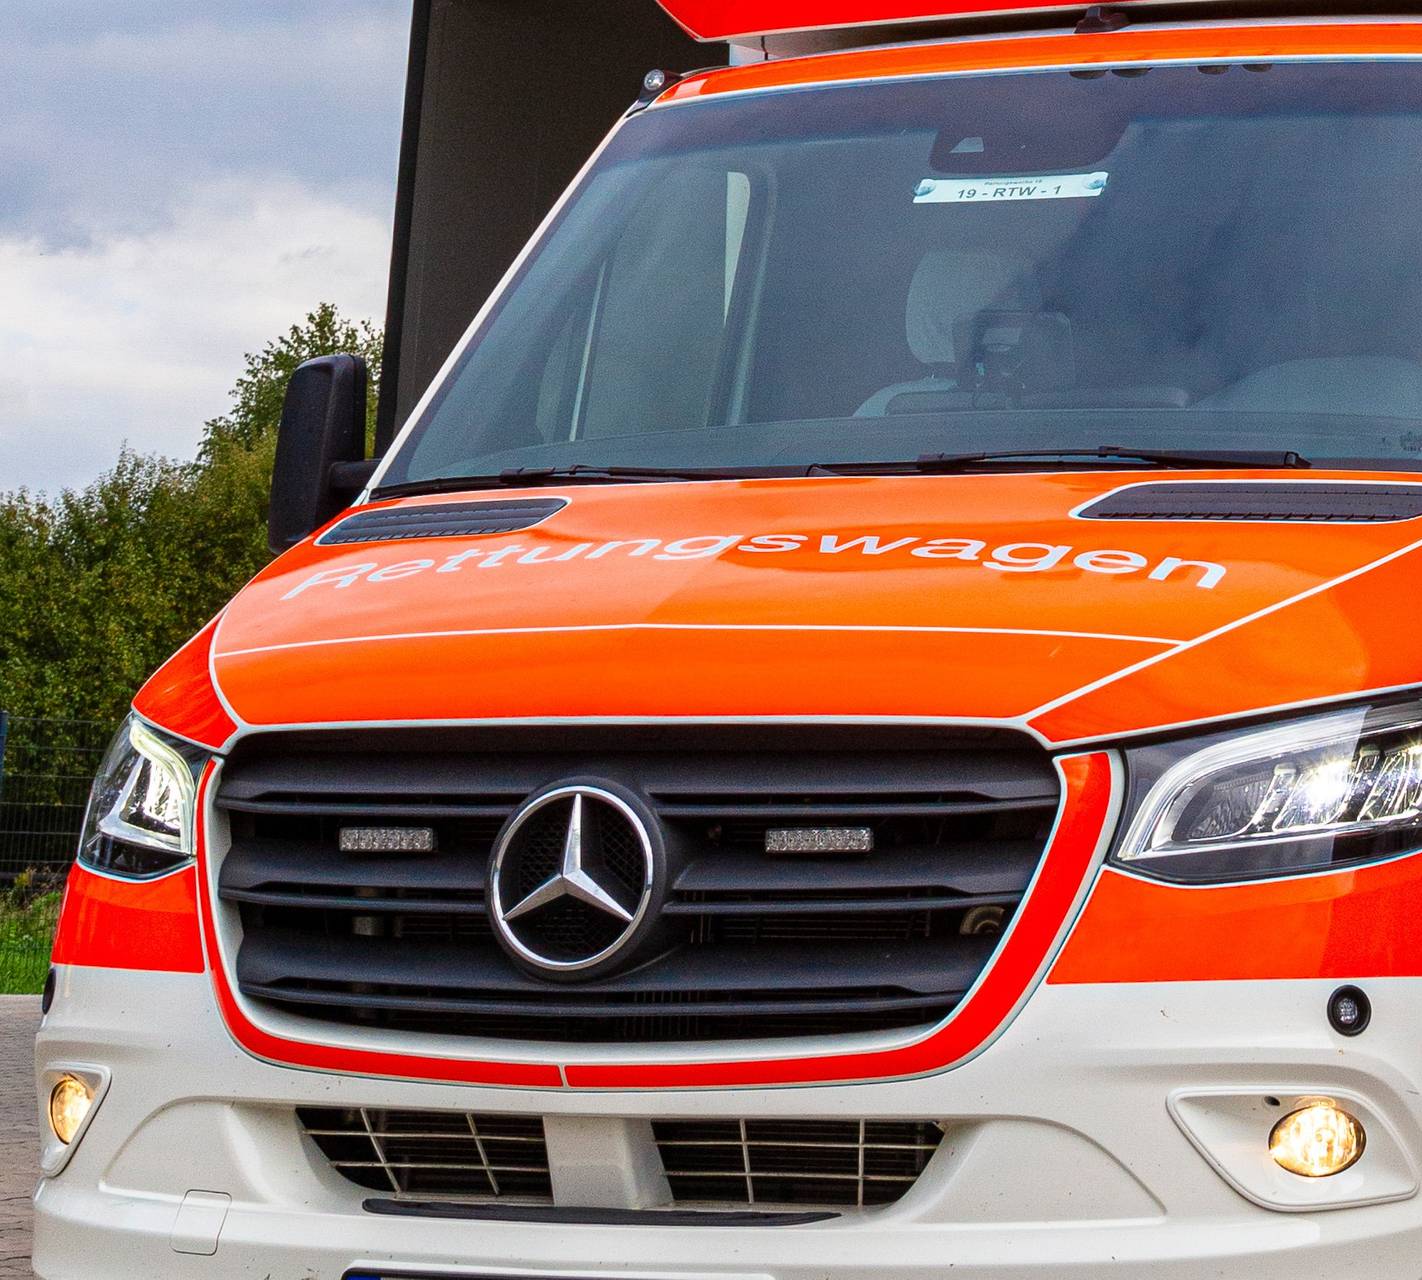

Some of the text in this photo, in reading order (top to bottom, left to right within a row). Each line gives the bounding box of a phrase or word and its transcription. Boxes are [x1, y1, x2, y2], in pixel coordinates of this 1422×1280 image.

[957, 188, 976, 199] 19
[992, 186, 1036, 198] RTW
[1053, 185, 1063, 195] 1
[281, 530, 1228, 600] Rettungswagen
